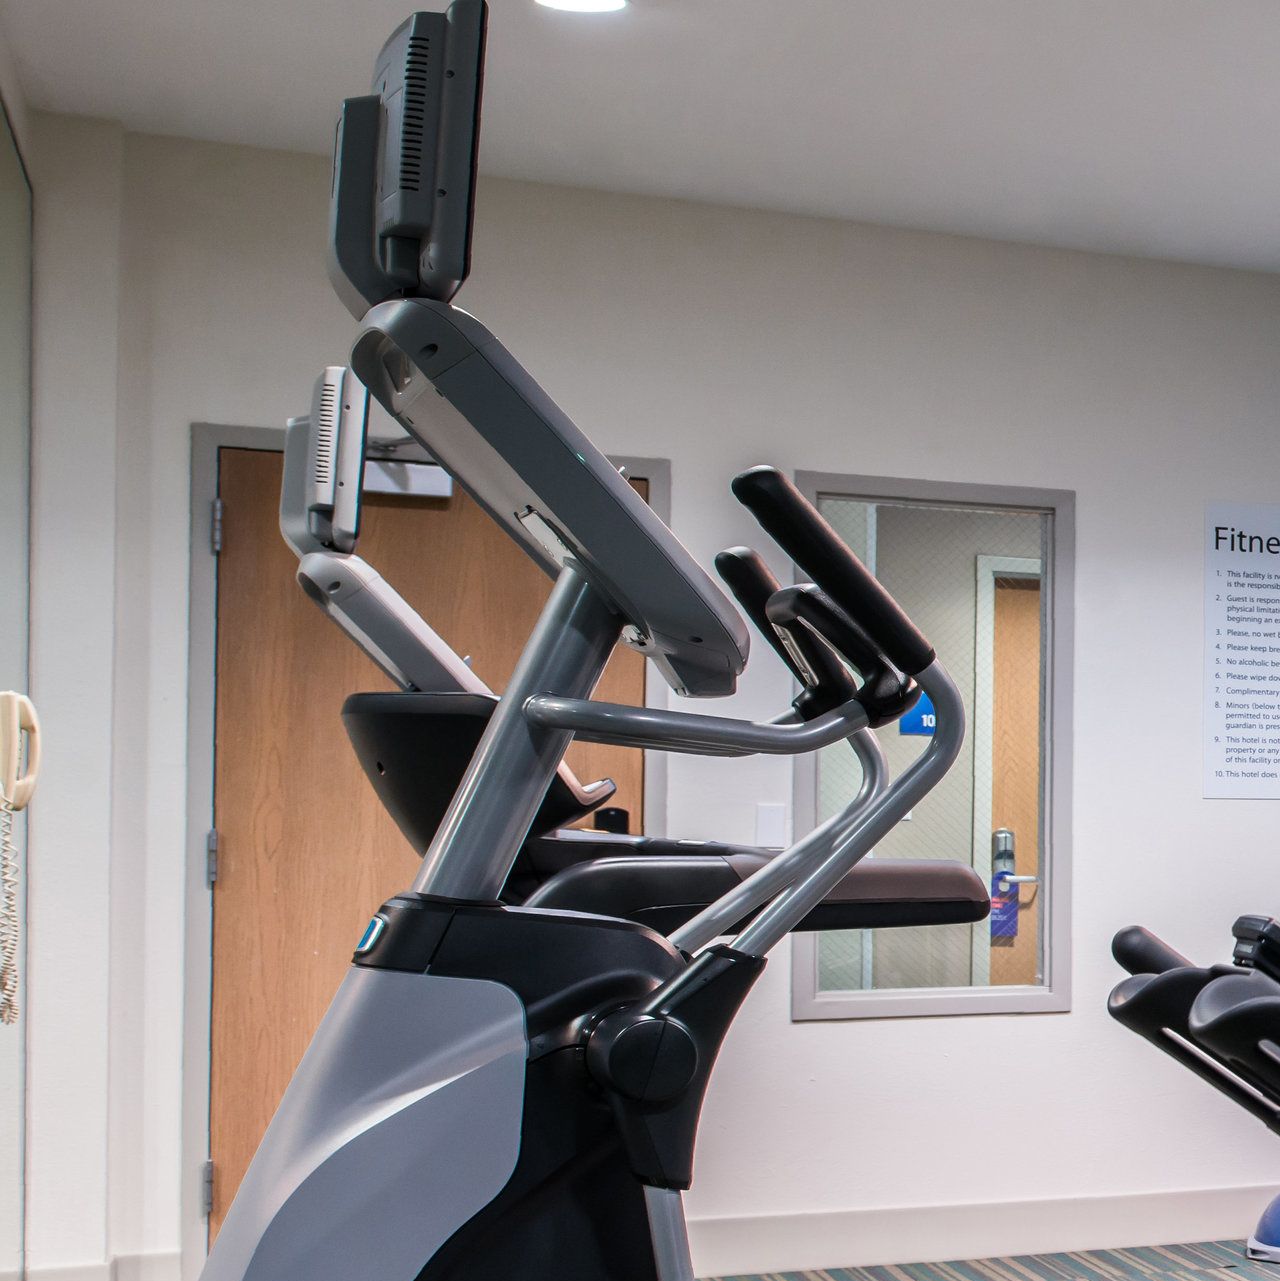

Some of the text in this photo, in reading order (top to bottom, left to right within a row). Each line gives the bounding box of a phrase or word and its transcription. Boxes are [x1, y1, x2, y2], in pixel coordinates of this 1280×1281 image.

[1227, 570, 1241, 578] This
[1242, 571, 1265, 581] facility
[1226, 605, 1254, 614] physical
[1226, 615, 1262, 624] beginning
[1250, 645, 1267, 654] keep
[1249, 674, 1267, 682] wipe
[1225, 687, 1280, 697] Complimentary
[1251, 703, 1275, 711] (below
[1225, 712, 1261, 721] permitted
[1225, 722, 1256, 731] guardian
[1225, 746, 1256, 755] property
[1248, 756, 1271, 765] facility
